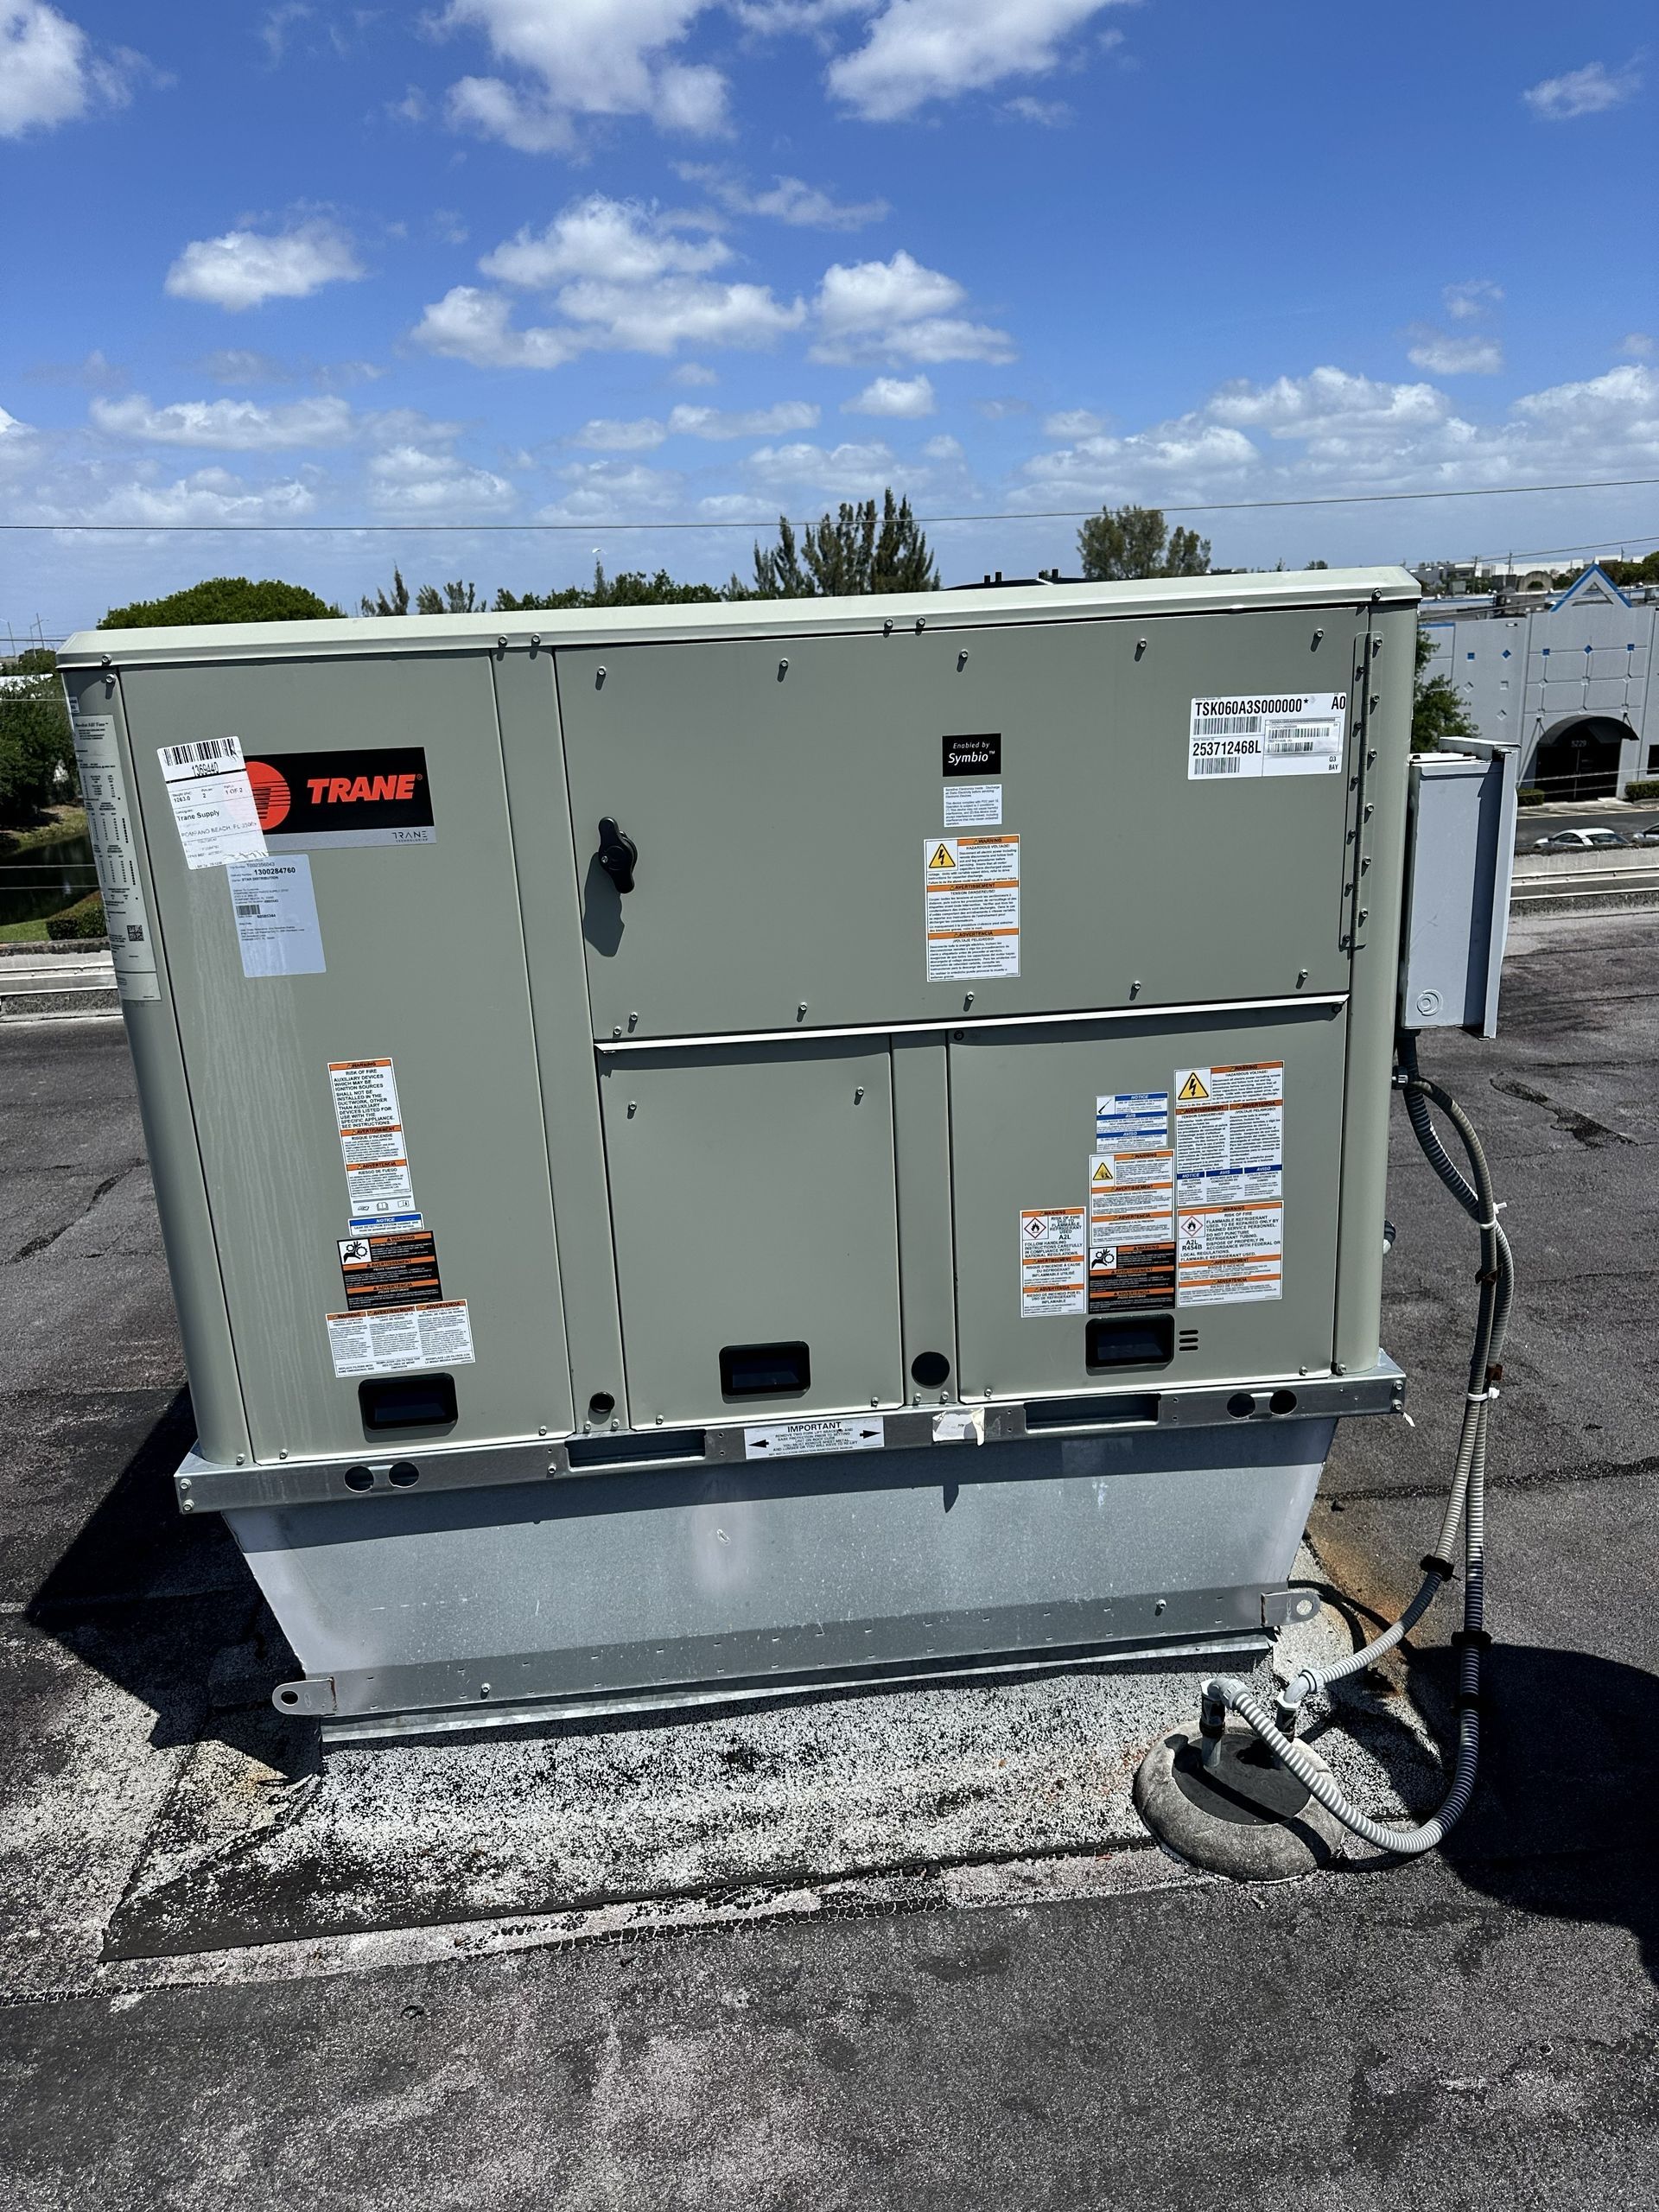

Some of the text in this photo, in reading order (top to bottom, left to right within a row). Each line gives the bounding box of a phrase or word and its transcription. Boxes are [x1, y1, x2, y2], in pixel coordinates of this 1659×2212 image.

[1332, 696, 1346, 710] A0
[1192, 741, 1262, 757] 253712468L
[176, 809, 220, 822] Trane Supply
[391, 830, 427, 839] TRANE
[787, 1421, 842, 1433] IMPORTANT
